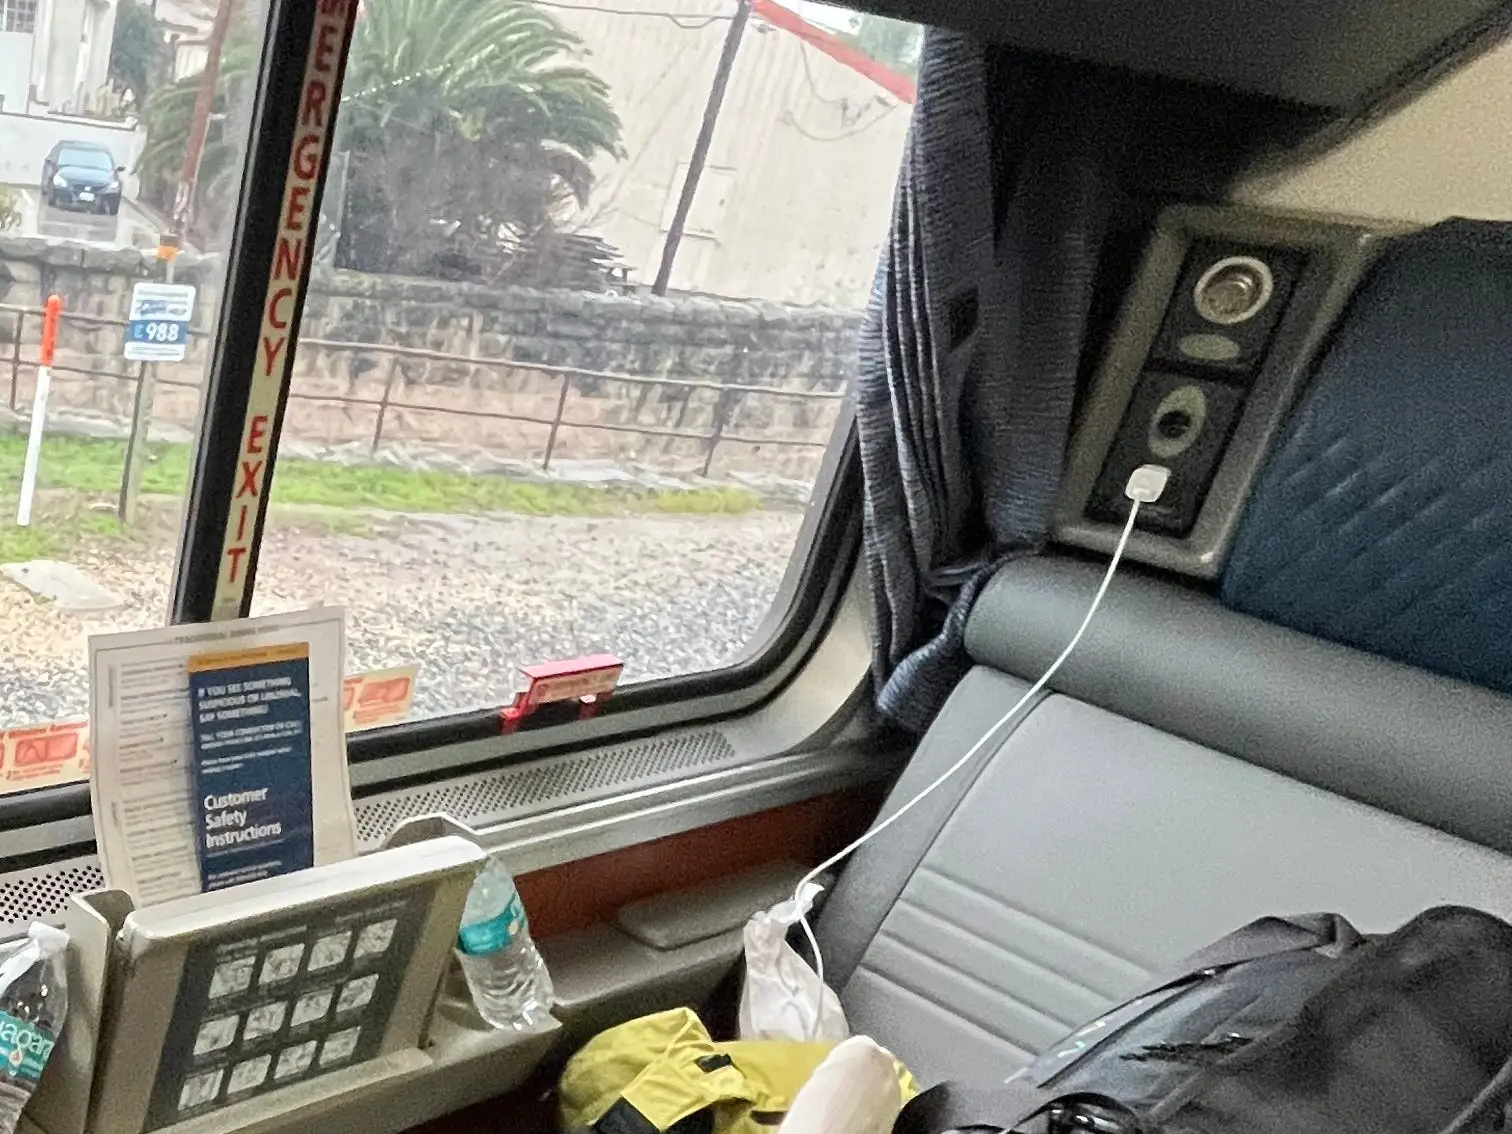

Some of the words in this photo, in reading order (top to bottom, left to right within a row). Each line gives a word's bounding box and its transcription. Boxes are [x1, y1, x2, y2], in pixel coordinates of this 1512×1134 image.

[145, 322, 180, 342] 988
[226, 415, 268, 583] EXIT
[207, 685, 227, 697] YOU
[227, 682, 242, 694] SEE
[242, 676, 292, 692] SOMETHING
[203, 787, 268, 811] Customer
[205, 809, 248, 831] Safety
[206, 821, 282, 849] Instructions
